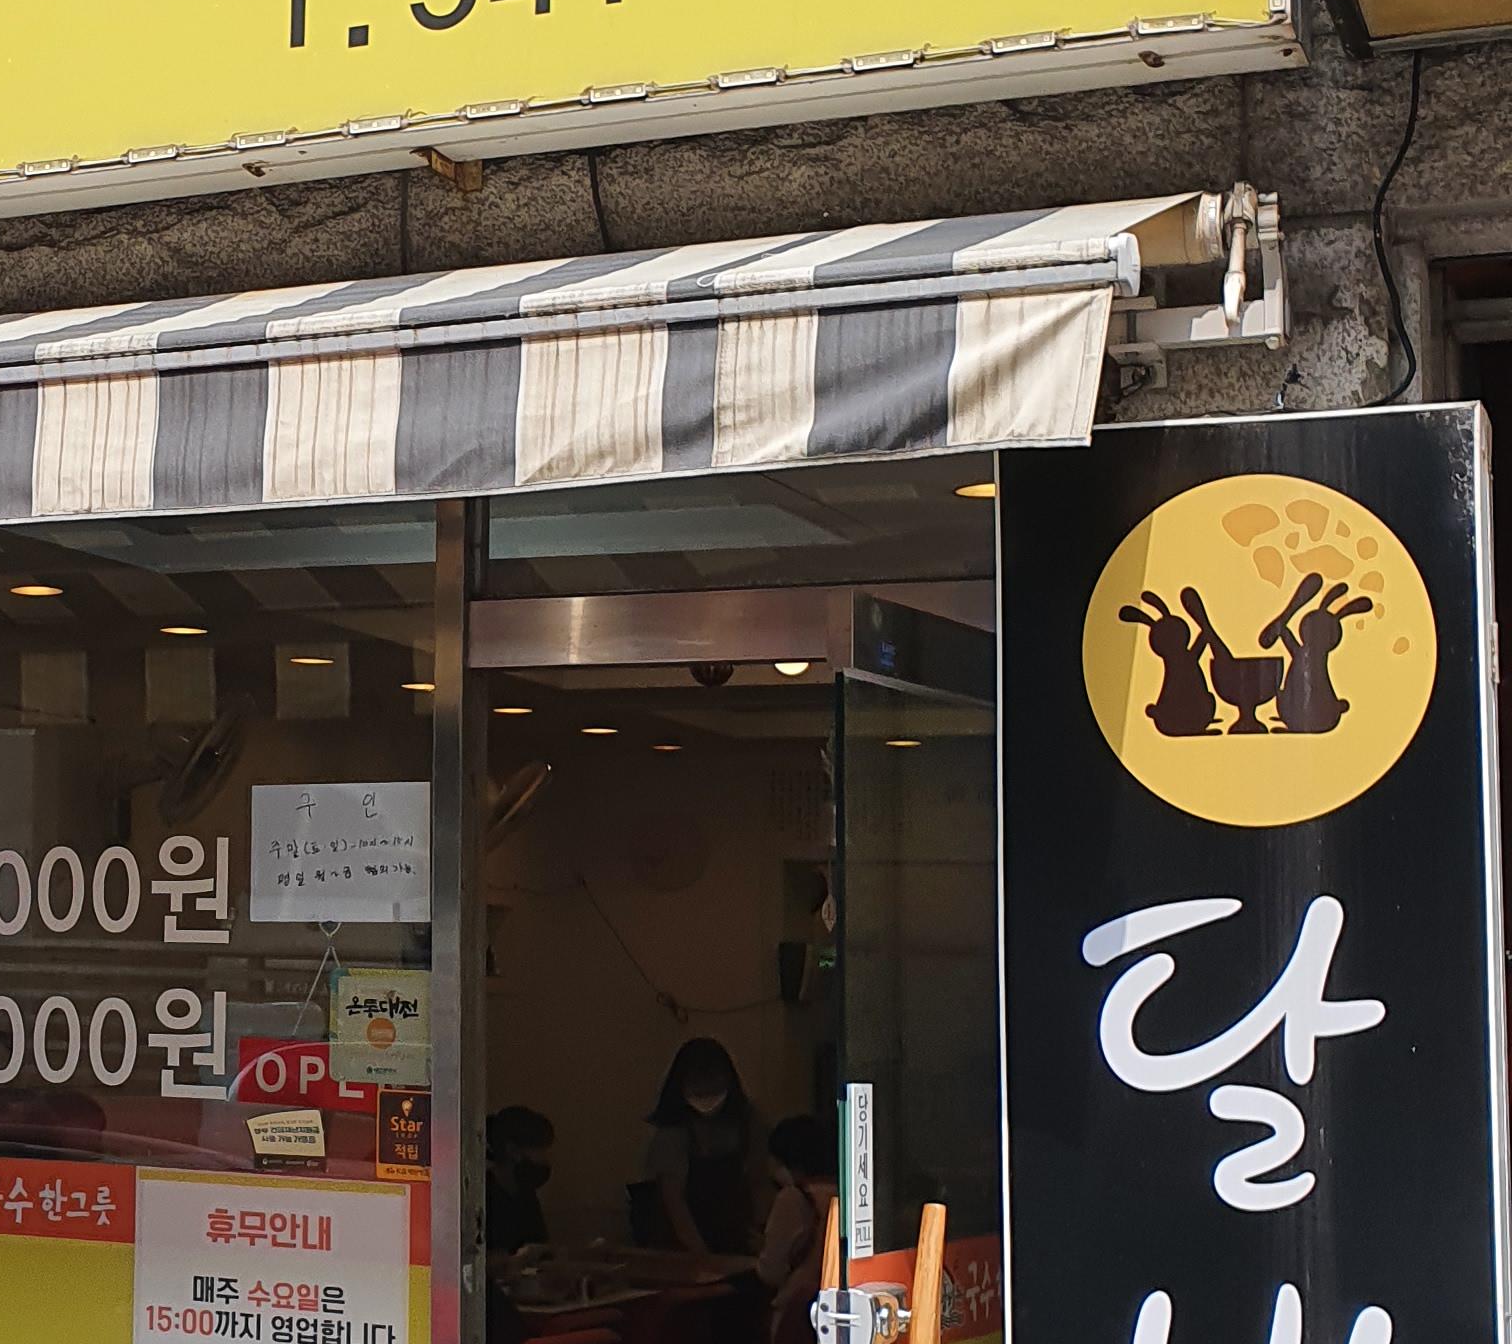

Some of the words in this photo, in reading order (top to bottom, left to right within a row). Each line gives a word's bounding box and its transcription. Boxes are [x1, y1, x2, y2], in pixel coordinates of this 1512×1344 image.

[390, 1117, 424, 1132] Star
[394, 1143, 419, 1161] 적립
[857, 1094, 869, 1207] 당기세요
[39, 1179, 116, 1226] 한그릇
[206, 1208, 332, 1252] 휴무안내
[856, 1227, 872, 1243] PULL
[192, 1275, 240, 1305] 매주
[247, 1280, 345, 1315] 수요일은
[146, 1305, 262, 1341] 15:00까지
